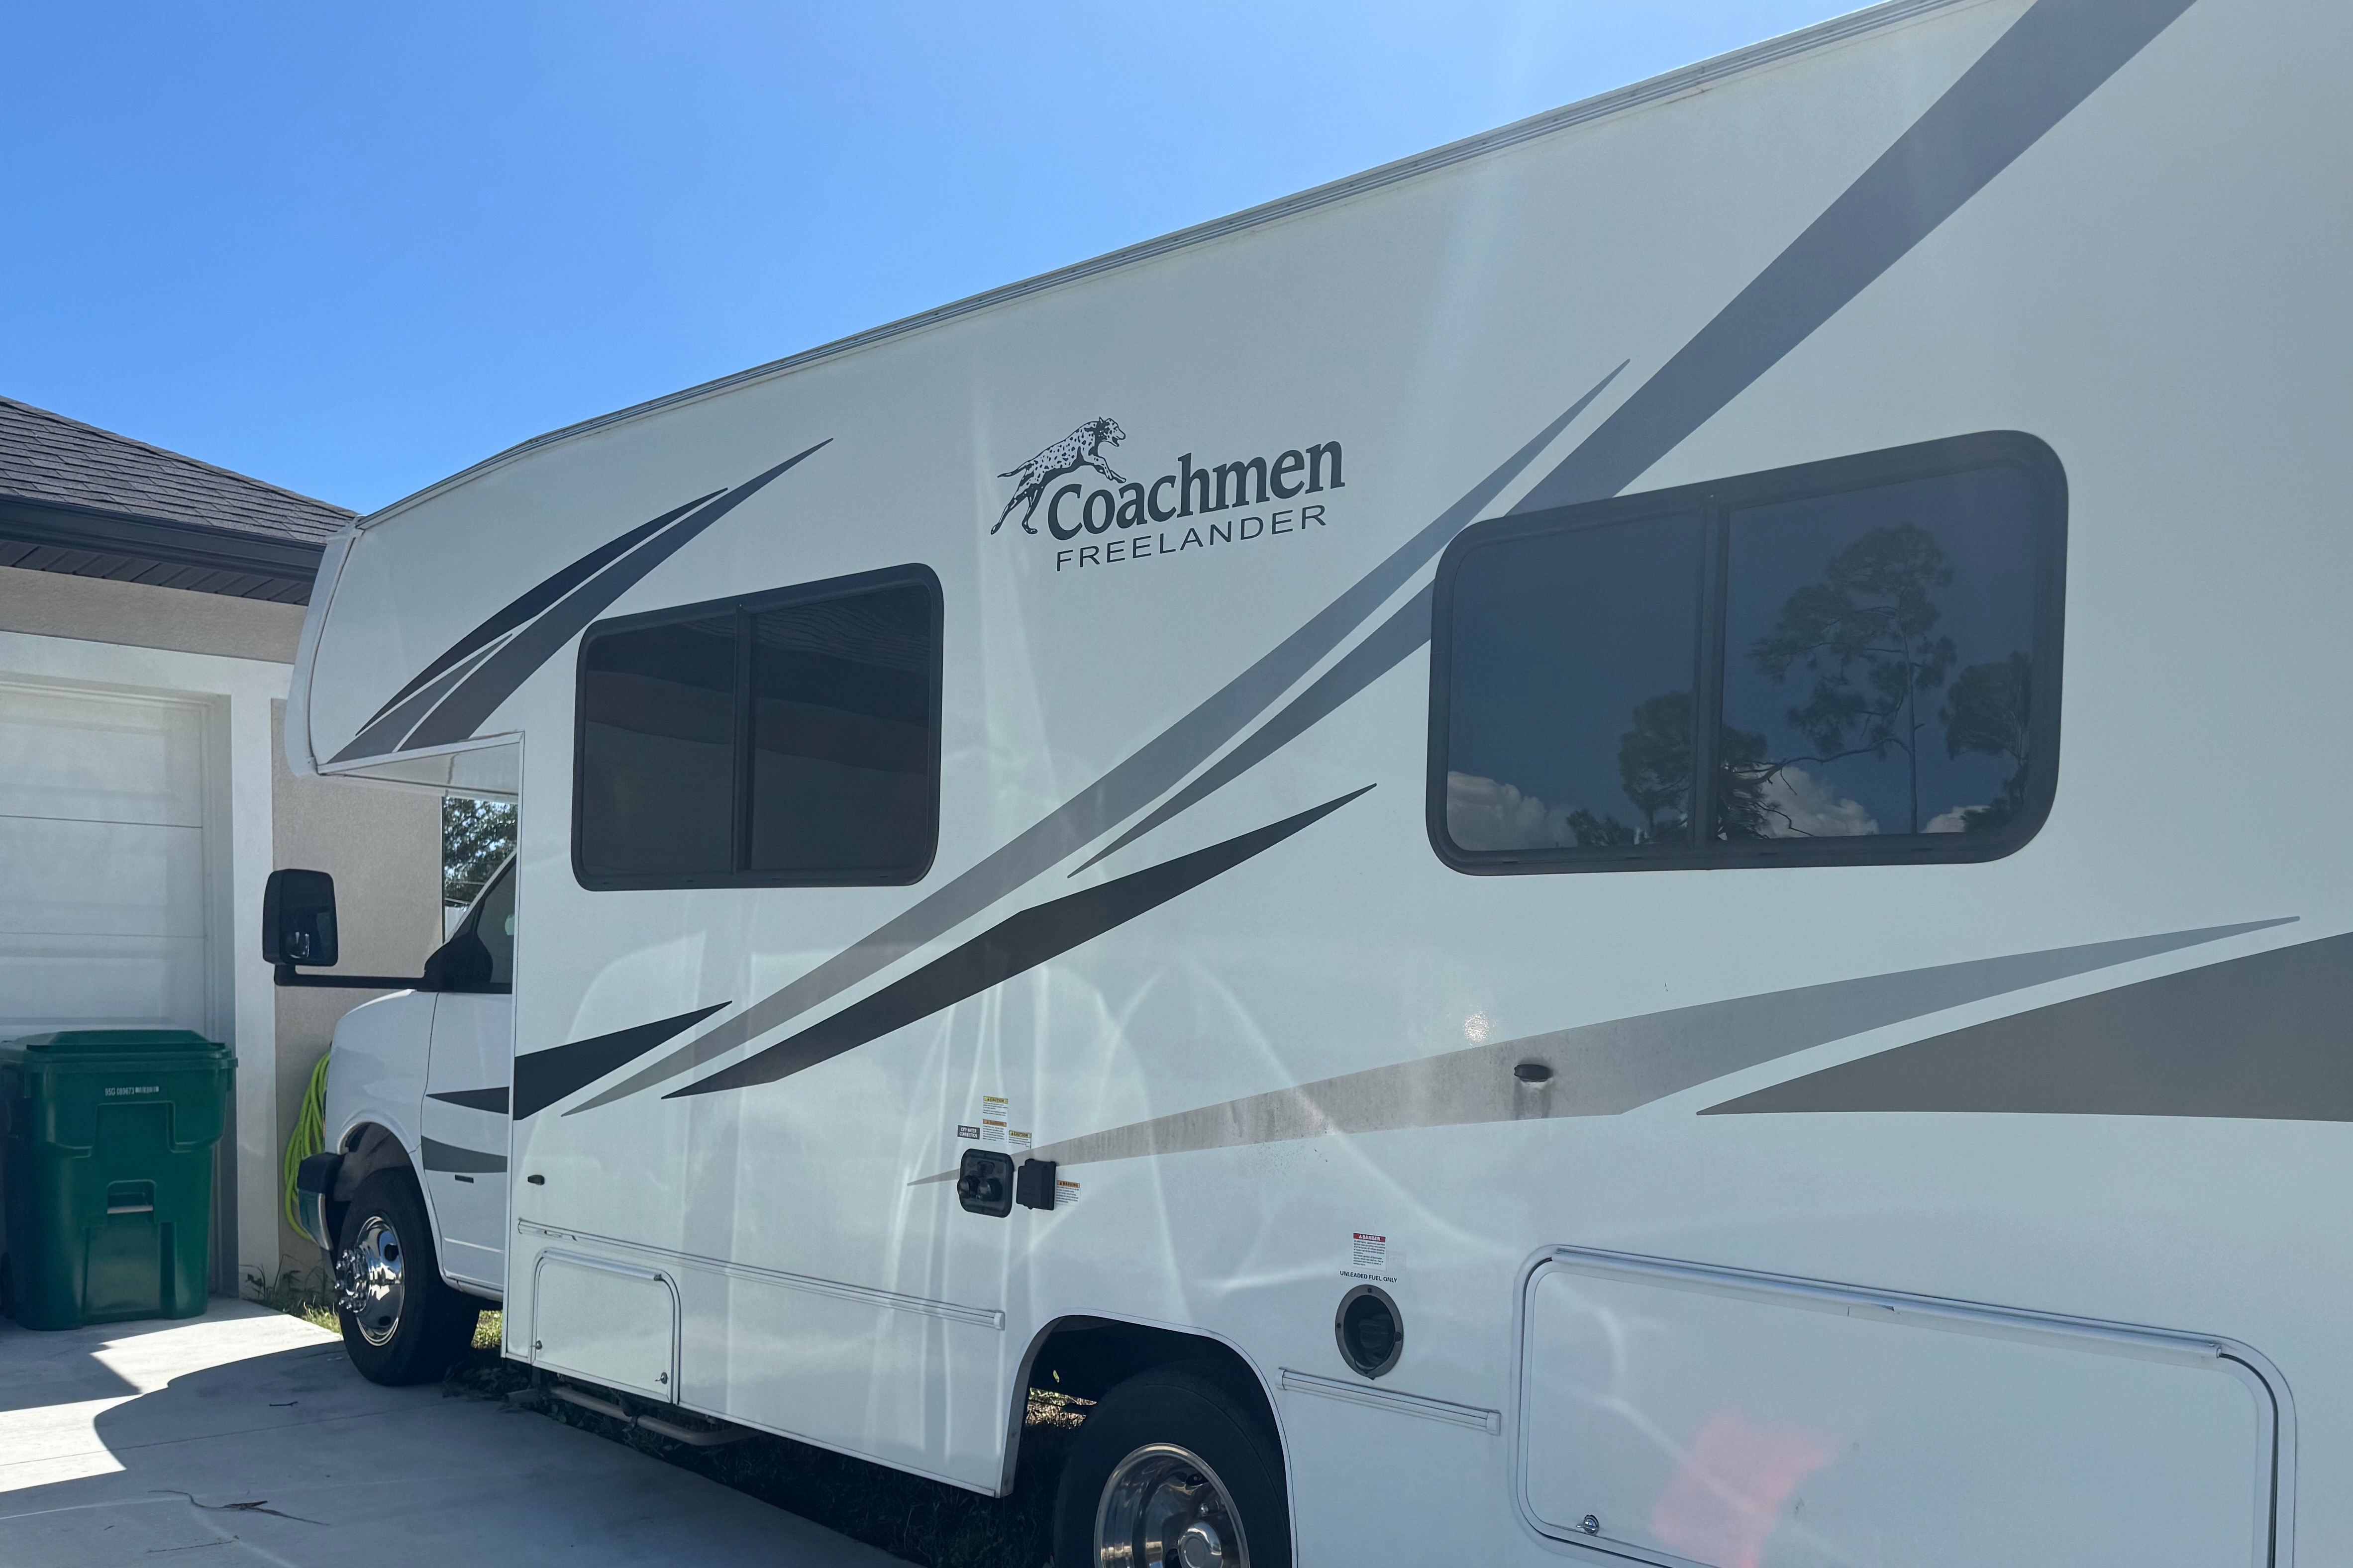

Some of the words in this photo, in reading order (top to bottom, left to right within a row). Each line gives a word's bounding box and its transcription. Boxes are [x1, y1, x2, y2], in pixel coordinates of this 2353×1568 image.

[1047, 441, 1345, 540] Coachmen
[1057, 504, 1326, 572] FREELANDER
[1340, 1271, 1368, 1279] UNLEADED
